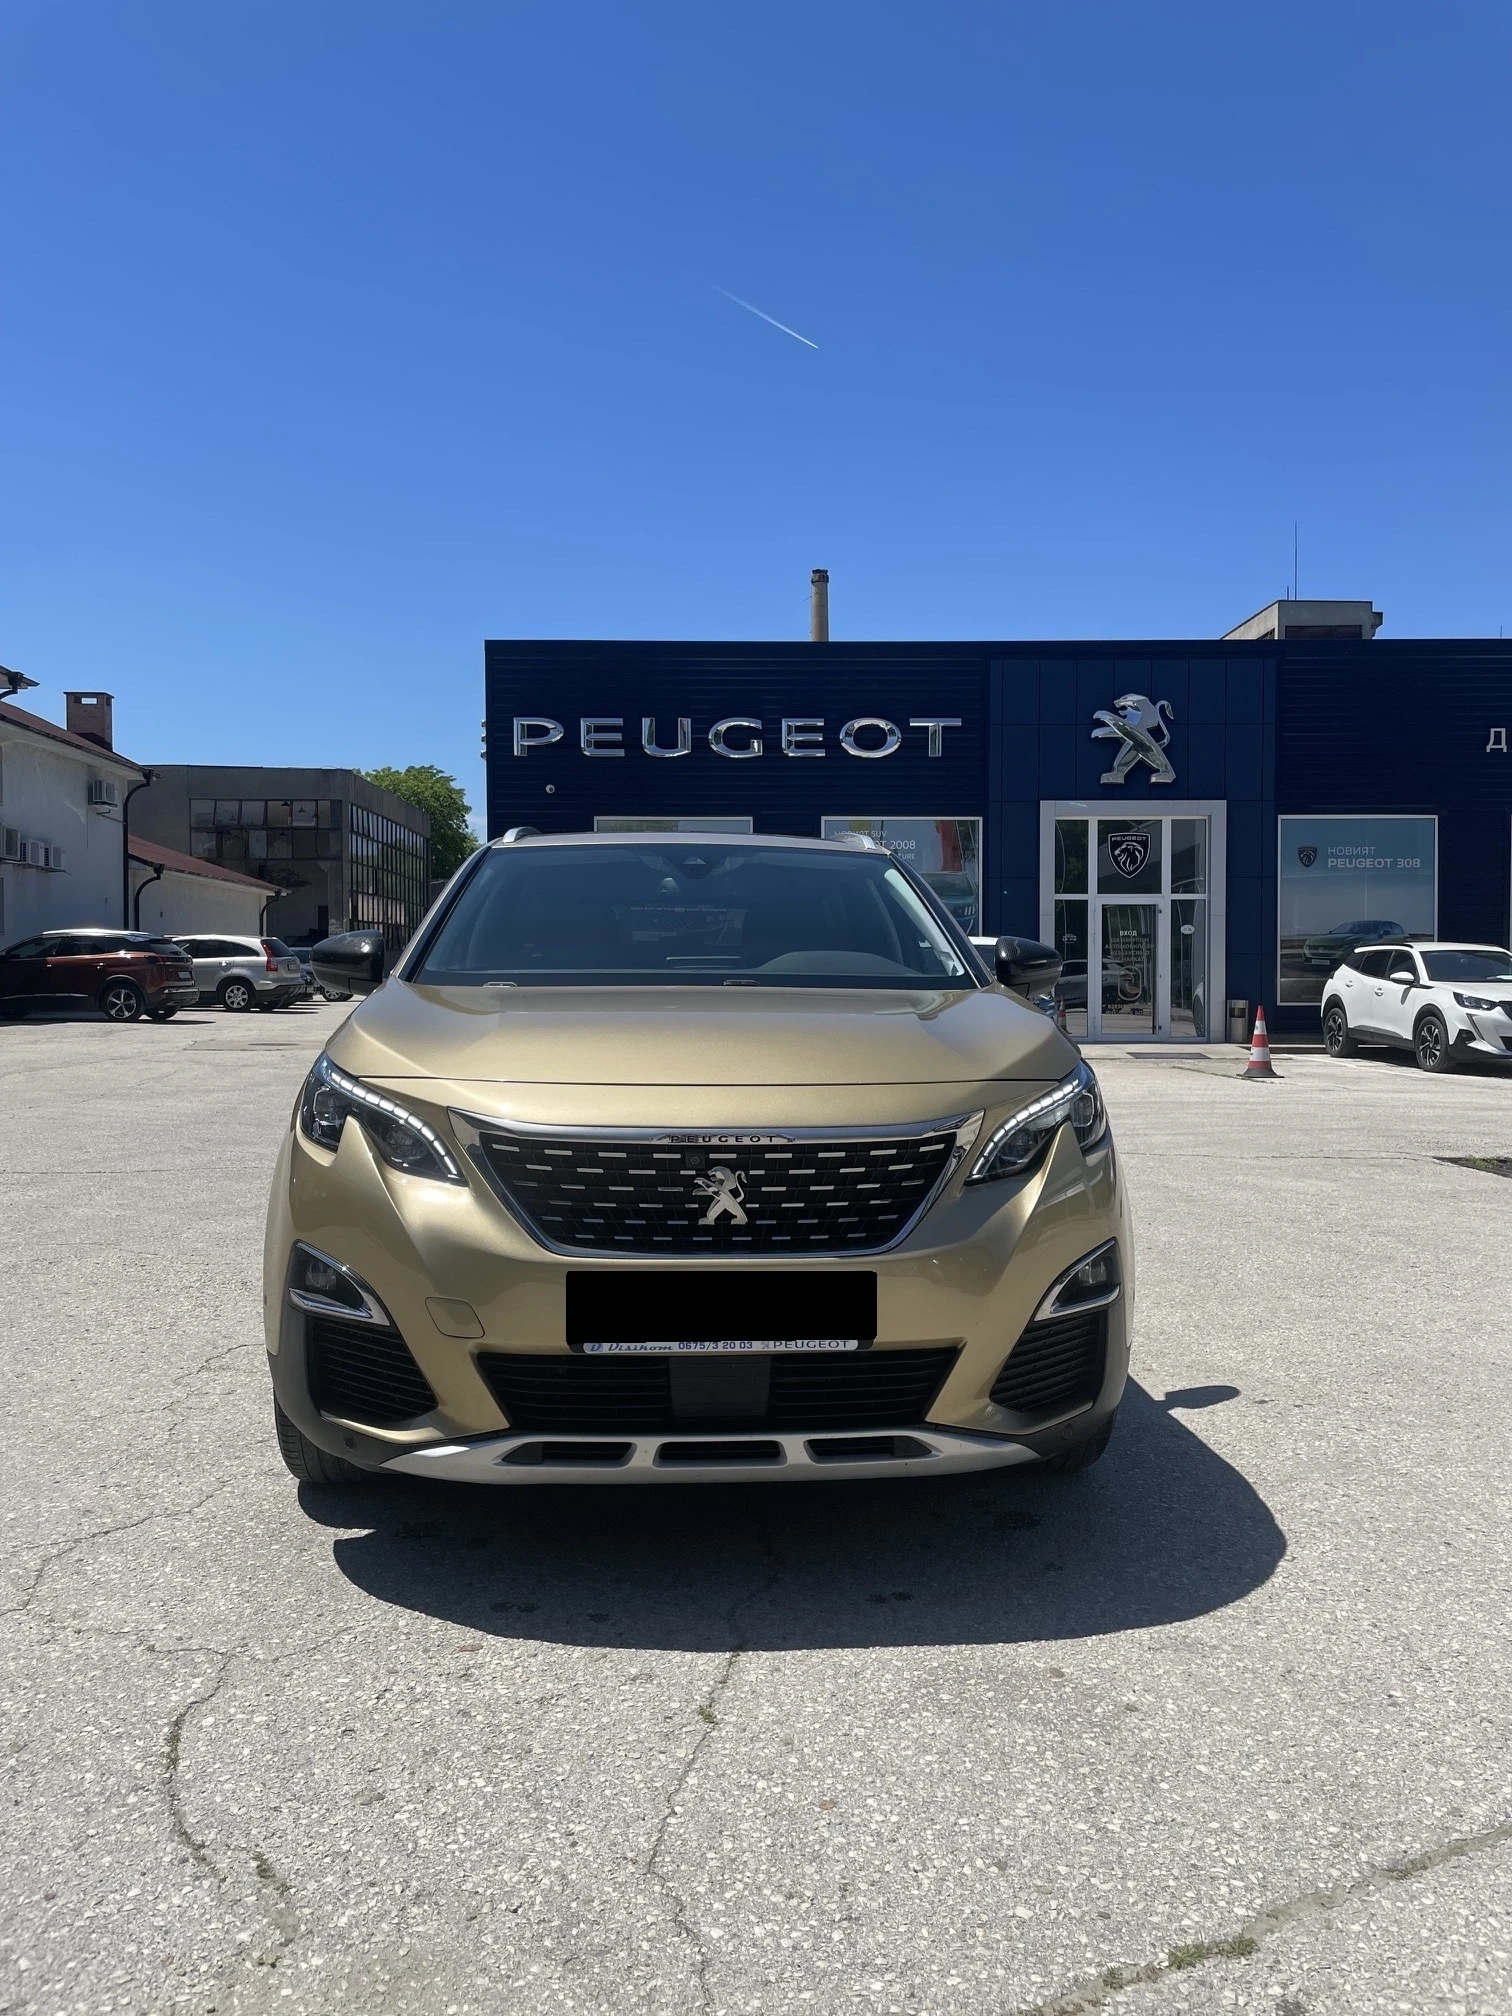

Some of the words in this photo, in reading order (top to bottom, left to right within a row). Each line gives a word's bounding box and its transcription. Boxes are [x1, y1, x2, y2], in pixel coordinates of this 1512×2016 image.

[513, 716, 963, 758] PEUGEOT
[871, 830, 887, 838] SUV
[889, 840, 916, 850] 2008
[1328, 846, 1377, 856] НОВИЯТ
[1328, 858, 1394, 868] PEUGEOT
[1396, 858, 1421, 868] 308
[670, 1135, 776, 1143] PEUGEOT
[678, 1341, 719, 1351] 0675/3
[722, 1341, 736, 1350] 20
[739, 1341, 753, 1349] 03
[773, 1340, 850, 1349] PEUGEOT
